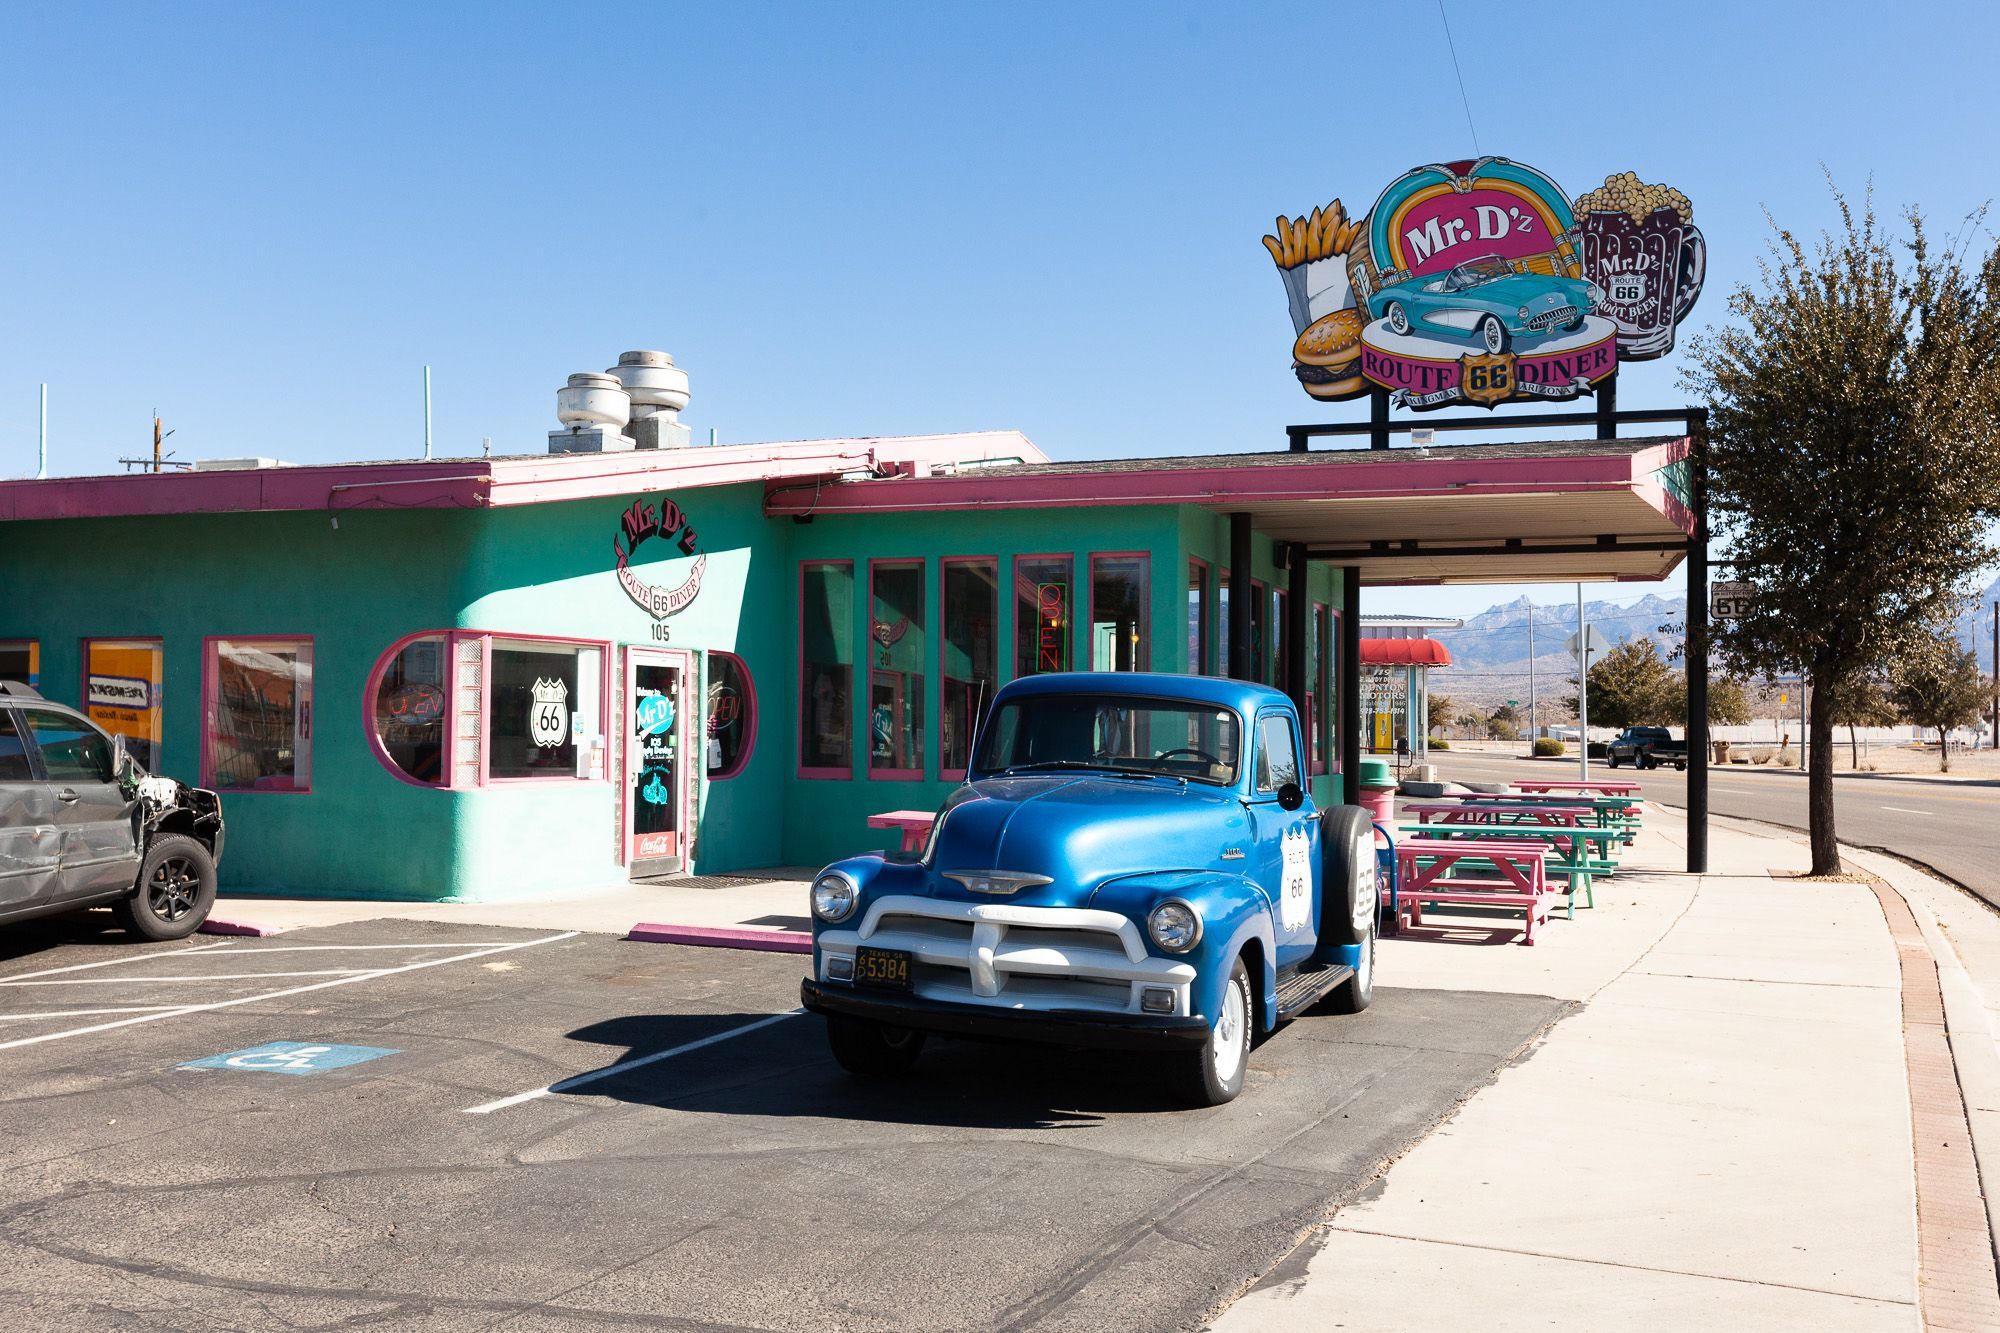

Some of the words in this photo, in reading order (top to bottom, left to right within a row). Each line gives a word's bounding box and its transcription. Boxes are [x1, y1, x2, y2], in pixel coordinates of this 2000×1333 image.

[1404, 215, 1473, 268] Mr.
[1600, 254, 1633, 276] Mr.
[1615, 286, 1639, 299] 66
[1600, 300, 1627, 317] ROOT
[1629, 296, 1659, 317] BEER
[1366, 351, 1453, 392] ROUTE
[1470, 364, 1507, 390] 66
[1517, 347, 1608, 384] DINER
[1409, 388, 1458, 405] KINGMAN
[1519, 382, 1571, 396] ARIZONA
[622, 498, 659, 551] Mr.
[619, 563, 650, 603] ROUTE
[653, 594, 668, 612] 66
[669, 578, 697, 607] DINER
[651, 624, 670, 641] 105
[1040, 584, 1061, 671] OPEN
[1360, 684, 1405, 692] DENTON
[1360, 692, 1405, 700] MOTORS
[540, 705, 560, 731] 66
[1291, 876, 1303, 899] 66
[1358, 868, 1373, 908] 66
